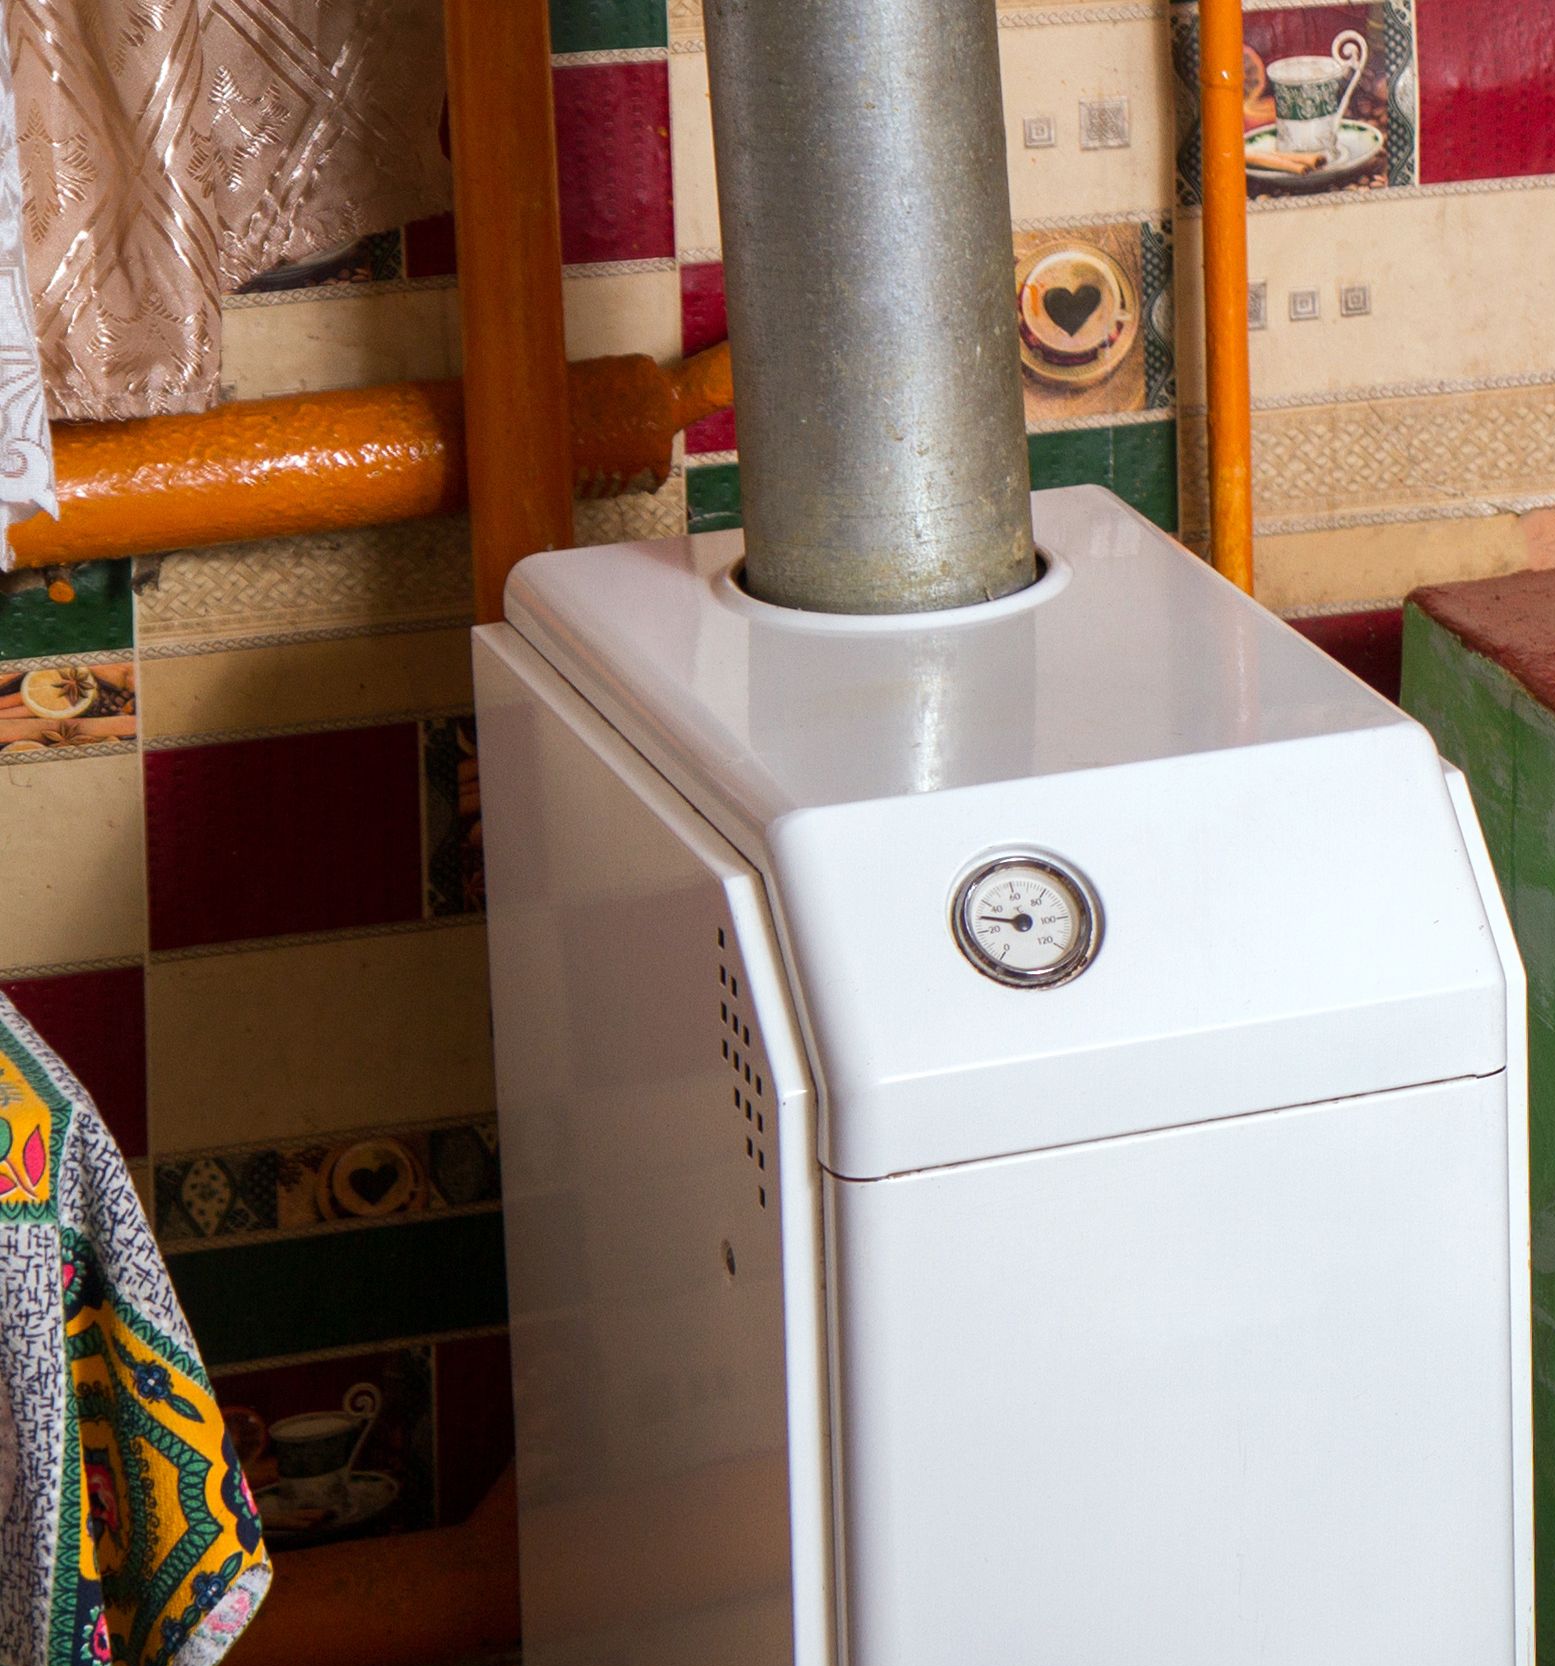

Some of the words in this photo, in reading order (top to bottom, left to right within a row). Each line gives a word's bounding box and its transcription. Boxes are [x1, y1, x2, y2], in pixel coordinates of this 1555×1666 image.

[1009, 892, 1021, 901] 60
[1030, 898, 1042, 907] 80
[992, 904, 1004, 913] 40
[1040, 915, 1056, 925] 100
[989, 925, 1001, 934] 20
[1037, 935, 1053, 945] 120
[1003, 943, 1010, 951] 0
